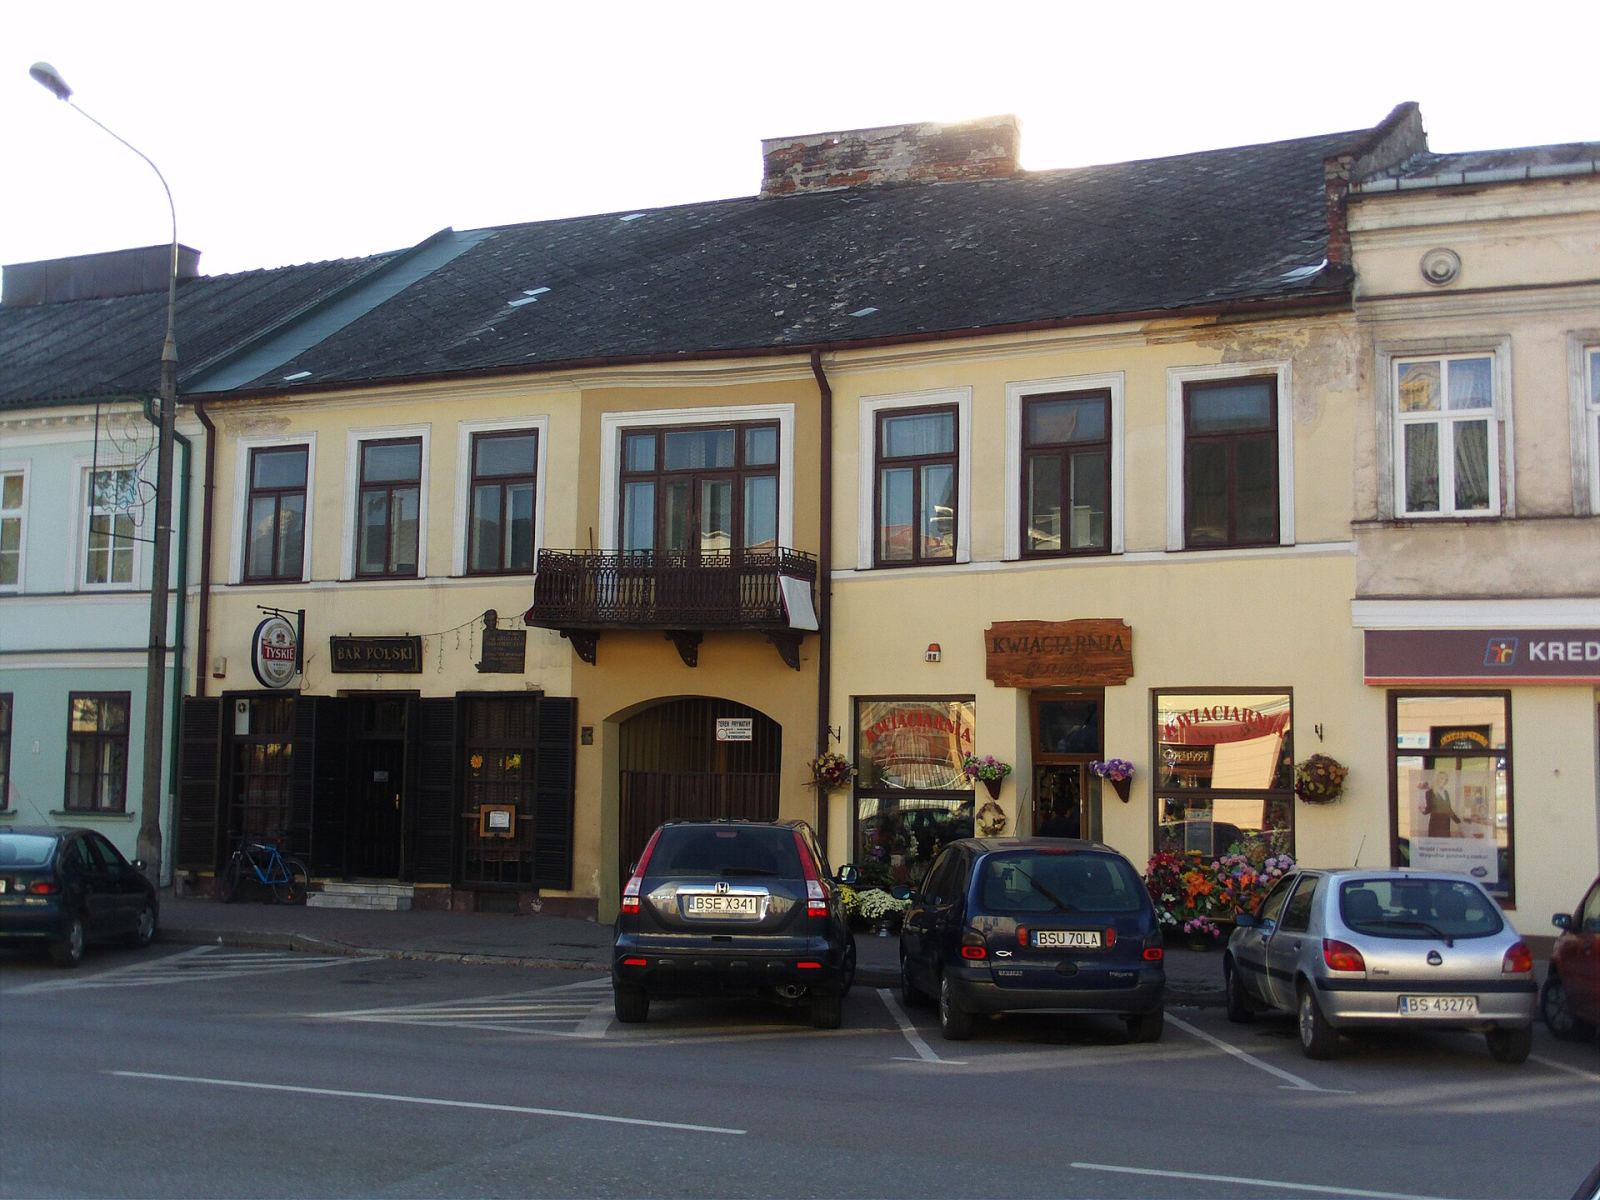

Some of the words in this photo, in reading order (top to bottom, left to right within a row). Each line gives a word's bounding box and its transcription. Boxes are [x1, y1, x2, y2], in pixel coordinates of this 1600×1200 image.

[992, 634, 1124, 655] KWIACIARNIA
[1529, 641, 1600, 661] KRED
[265, 646, 294, 660] TYSKIE
[338, 647, 361, 660] BAR
[367, 646, 412, 661] POLSKI
[696, 898, 721, 910] BSE
[726, 898, 753, 910] X341
[1039, 933, 1065, 945] BSU
[1069, 933, 1098, 945] 70LA
[1409, 999, 1428, 1012] BS
[1433, 999, 1474, 1012] 43279
